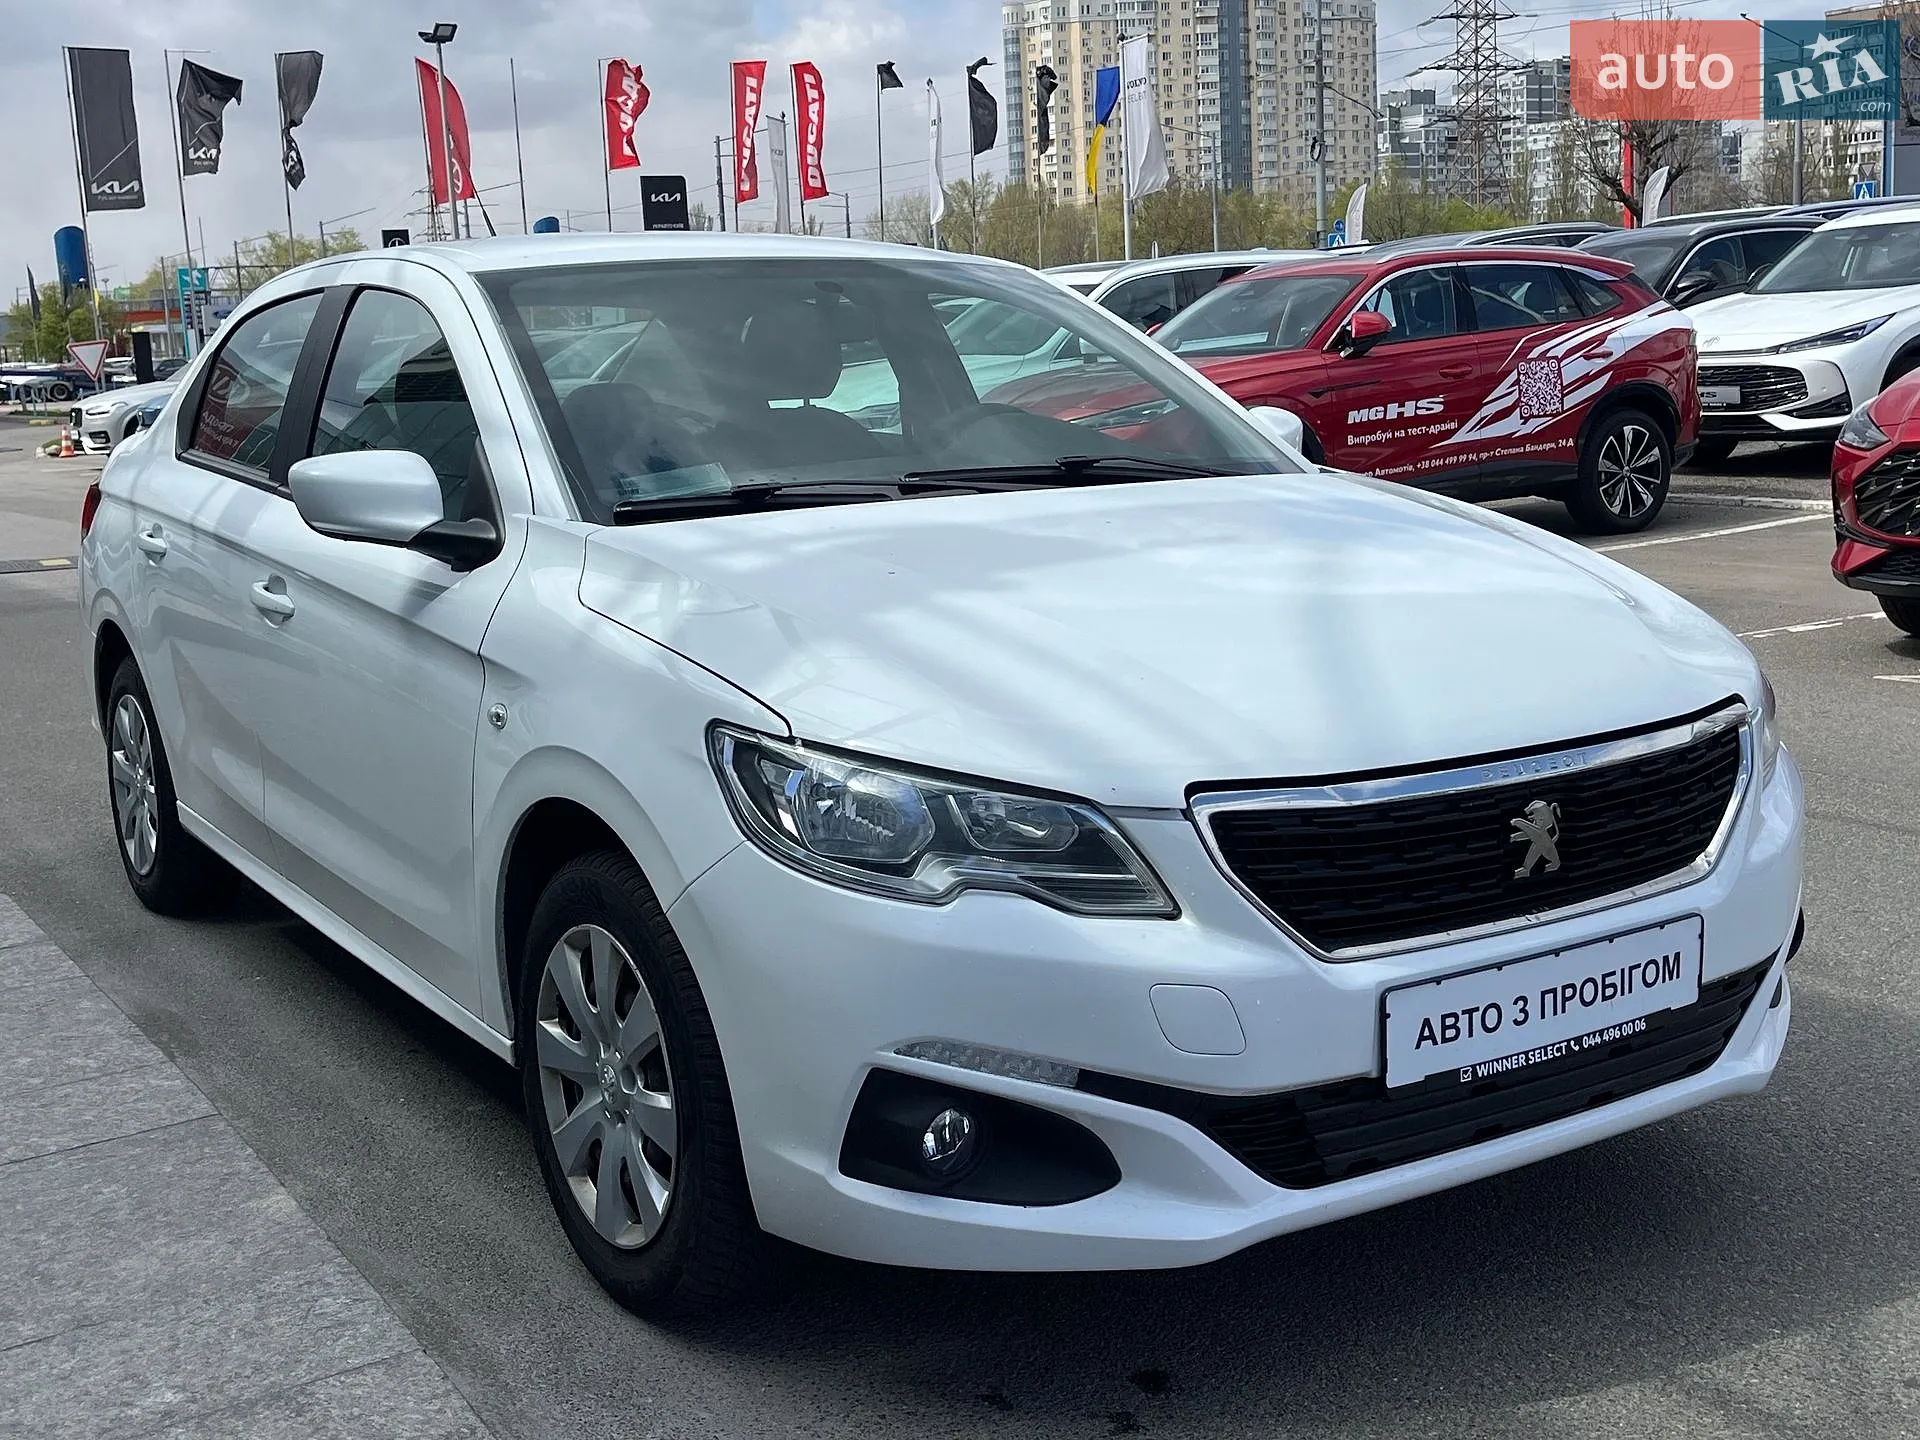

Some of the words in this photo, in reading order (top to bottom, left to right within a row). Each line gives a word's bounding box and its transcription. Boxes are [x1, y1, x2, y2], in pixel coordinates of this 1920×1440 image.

[617, 64, 639, 157] DUCA
[740, 76, 757, 192] DUCATI
[803, 73, 822, 188] DUCATI
[91, 180, 139, 195] KIA
[651, 192, 681, 202] KIA
[1347, 429, 1393, 445] Випробуй
[1394, 429, 1406, 438] на
[1407, 419, 1458, 436] тест-драйві
[1416, 460, 1430, 470] +38
[1430, 458, 1443, 468] 044
[1444, 455, 1457, 465] 499
[1415, 1001, 1502, 1050] АВТО
[1540, 951, 1681, 1020] ПРОБІГОМ
[1476, 1054, 1526, 1078] WINNER
[1528, 1042, 1567, 1064] SELECT
[1582, 1032, 1601, 1049] 044
[1602, 1025, 1621, 1042] 496
[1621, 1021, 1634, 1037] 00
[1634, 1018, 1647, 1033] 06
